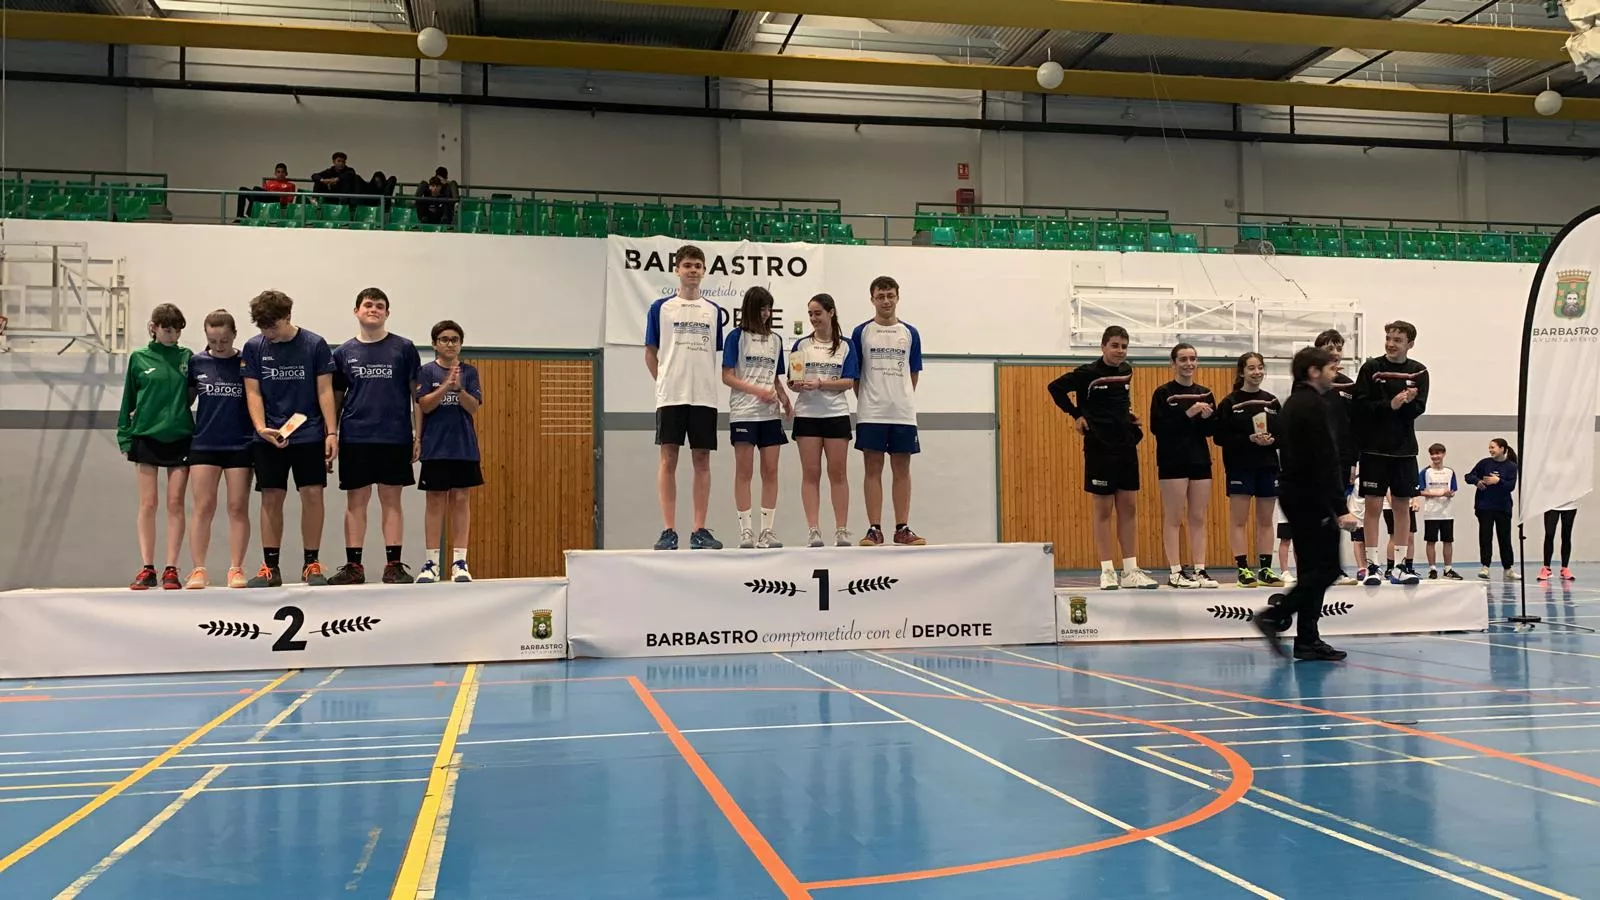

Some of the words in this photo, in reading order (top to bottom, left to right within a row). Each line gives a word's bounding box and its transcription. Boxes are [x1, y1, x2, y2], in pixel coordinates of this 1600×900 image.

[625, 249, 808, 277] BAASTRO
[1533, 326, 1599, 336] BARBASTRO
[271, 368, 305, 377] Daroca
[360, 366, 392, 375] Daroca
[206, 383, 243, 394] Daroca
[812, 568, 830, 611] 1
[271, 605, 308, 652] 2
[646, 629, 758, 647] BARBASTRO
[762, 619, 862, 648] comprometido
[866, 628, 890, 640] con
[895, 618, 908, 639] el
[912, 623, 992, 638] DEPORTE
